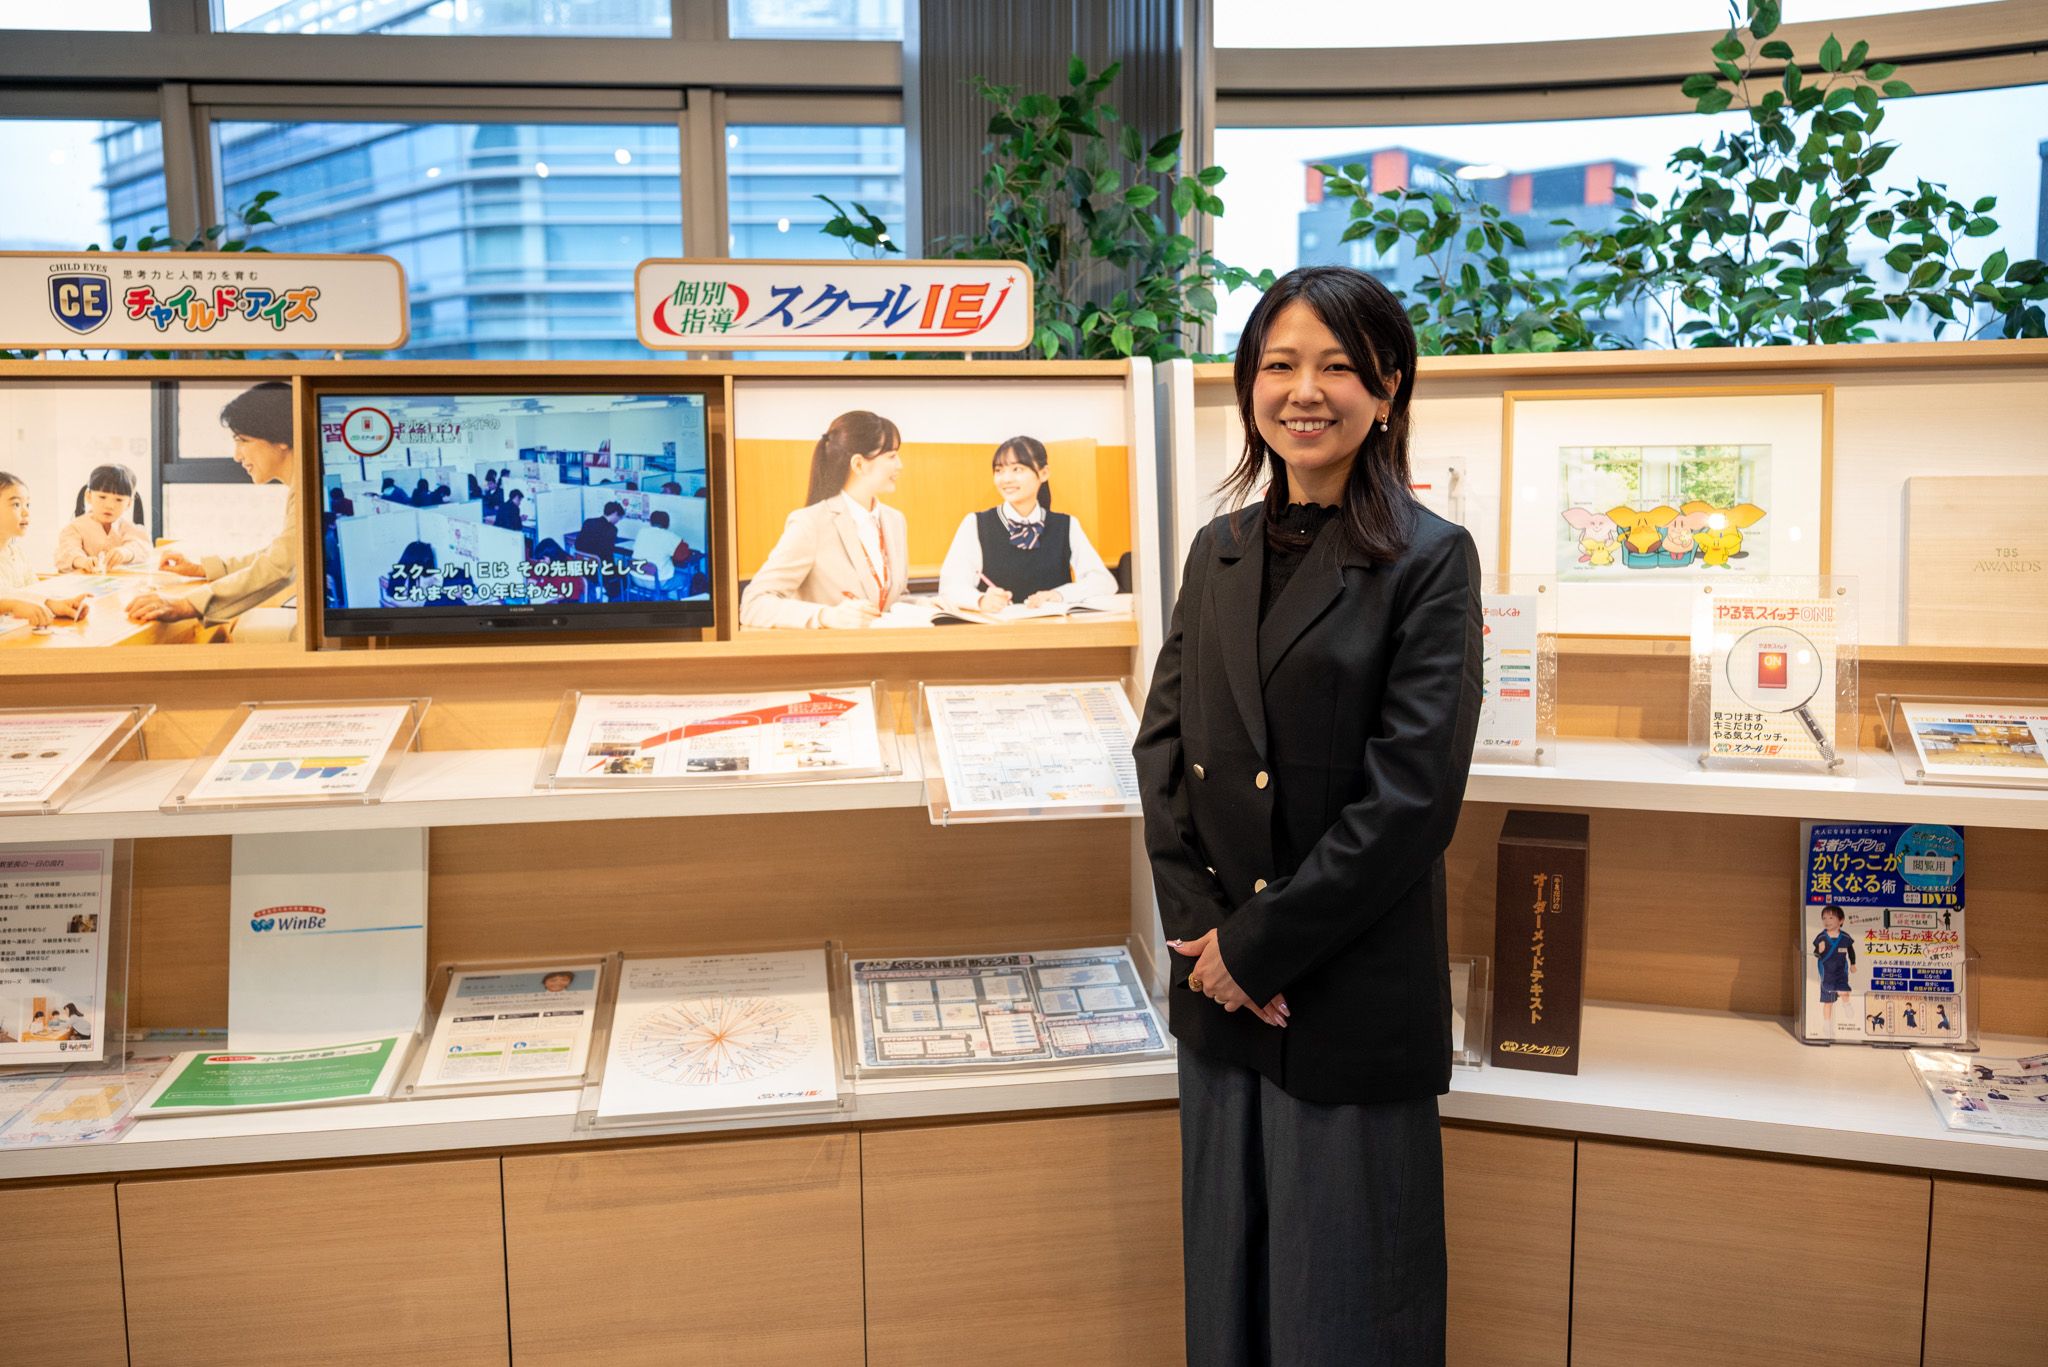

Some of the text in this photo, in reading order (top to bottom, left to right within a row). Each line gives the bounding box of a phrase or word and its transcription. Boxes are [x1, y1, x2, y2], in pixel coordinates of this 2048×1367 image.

[49, 262, 108, 273] CHILD EYES
[122, 268, 260, 281] 思考力と人間力を育む
[672, 280, 729, 306] 個別
[57, 283, 104, 318] CE
[681, 307, 740, 334] 指導
[1995, 548, 2019, 557] TBS
[518, 559, 648, 578] その先駆けとして
[1973, 560, 2042, 573] AWARDS
[1763, 655, 1782, 666] ON
[1713, 712, 1769, 722] 見つけます、
[1713, 721, 1763, 731] キミだけの
[1713, 731, 1788, 742] やる気スイッチ。
[1812, 852, 1904, 872] かけっこが
[1912, 859, 1947, 872] 閲覧用
[1811, 872, 1897, 895] 速くなる術
[1921, 893, 1957, 905] DVD
[278, 916, 327, 931] WinBe
[1864, 929, 1959, 942] 本当に足が速くなる
[1529, 872, 1548, 1024] オーダーメイドテキスト
[1864, 943, 1922, 955] すごい方法
